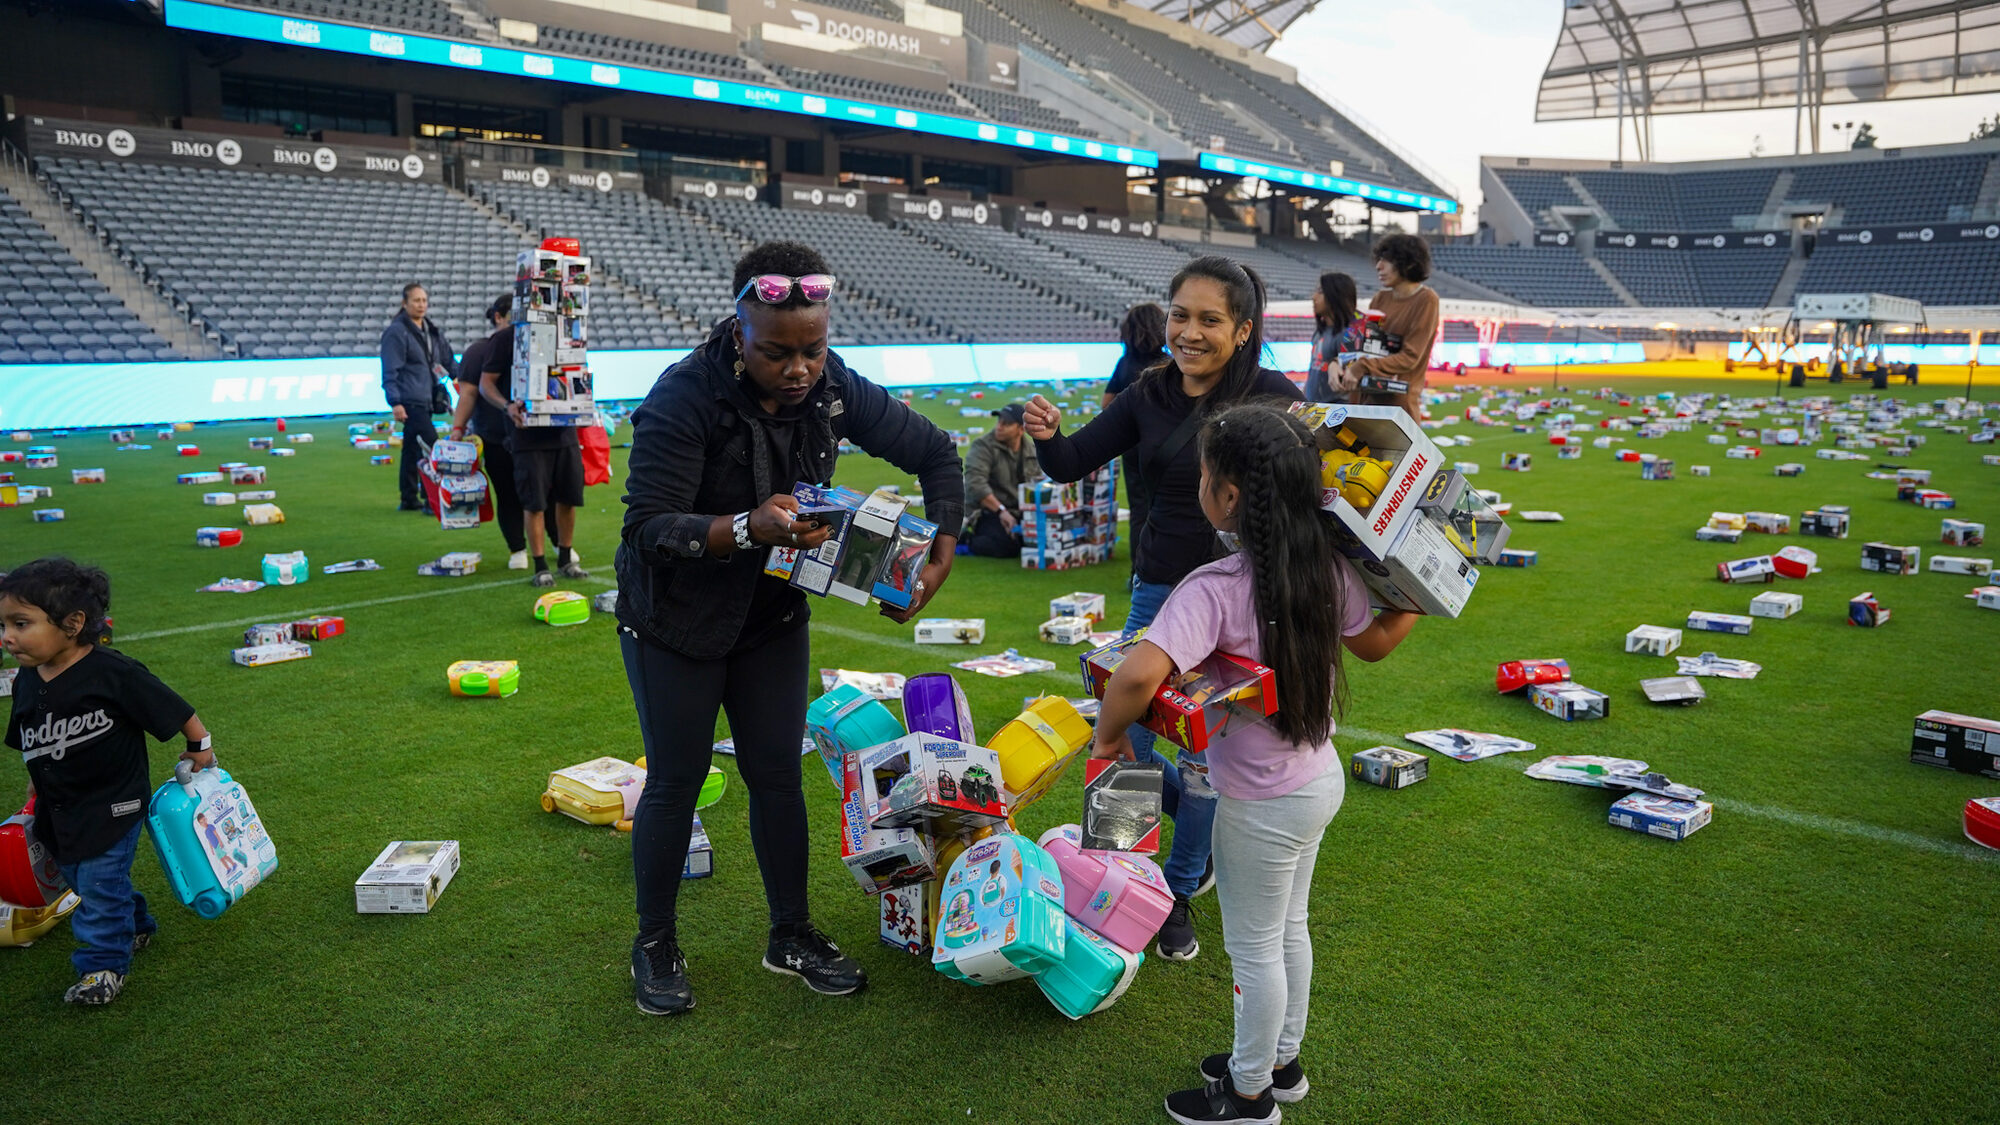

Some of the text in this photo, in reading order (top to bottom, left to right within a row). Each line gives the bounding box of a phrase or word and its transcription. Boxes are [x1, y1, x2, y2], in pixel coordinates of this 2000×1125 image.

[825, 20, 920, 55] DOORDASH
[55, 129, 104, 148] BMO
[171, 140, 214, 158] BMO
[273, 148, 311, 165] BMO
[364, 156, 400, 172] BMO
[502, 168, 530, 182] BMO
[568, 173, 595, 187] BMO
[903, 201, 928, 214] BMO
[951, 205, 974, 219] BMO
[211, 373, 374, 404] RITFIT
[1373, 453, 1428, 536] TRANSFORMERS
[924, 743, 942, 752] FORD
[846, 803, 857, 826] F-150
[853, 792, 863, 821] RAPTOR
[851, 826, 864, 852] FORD
[30, 843, 41, 856] 19
